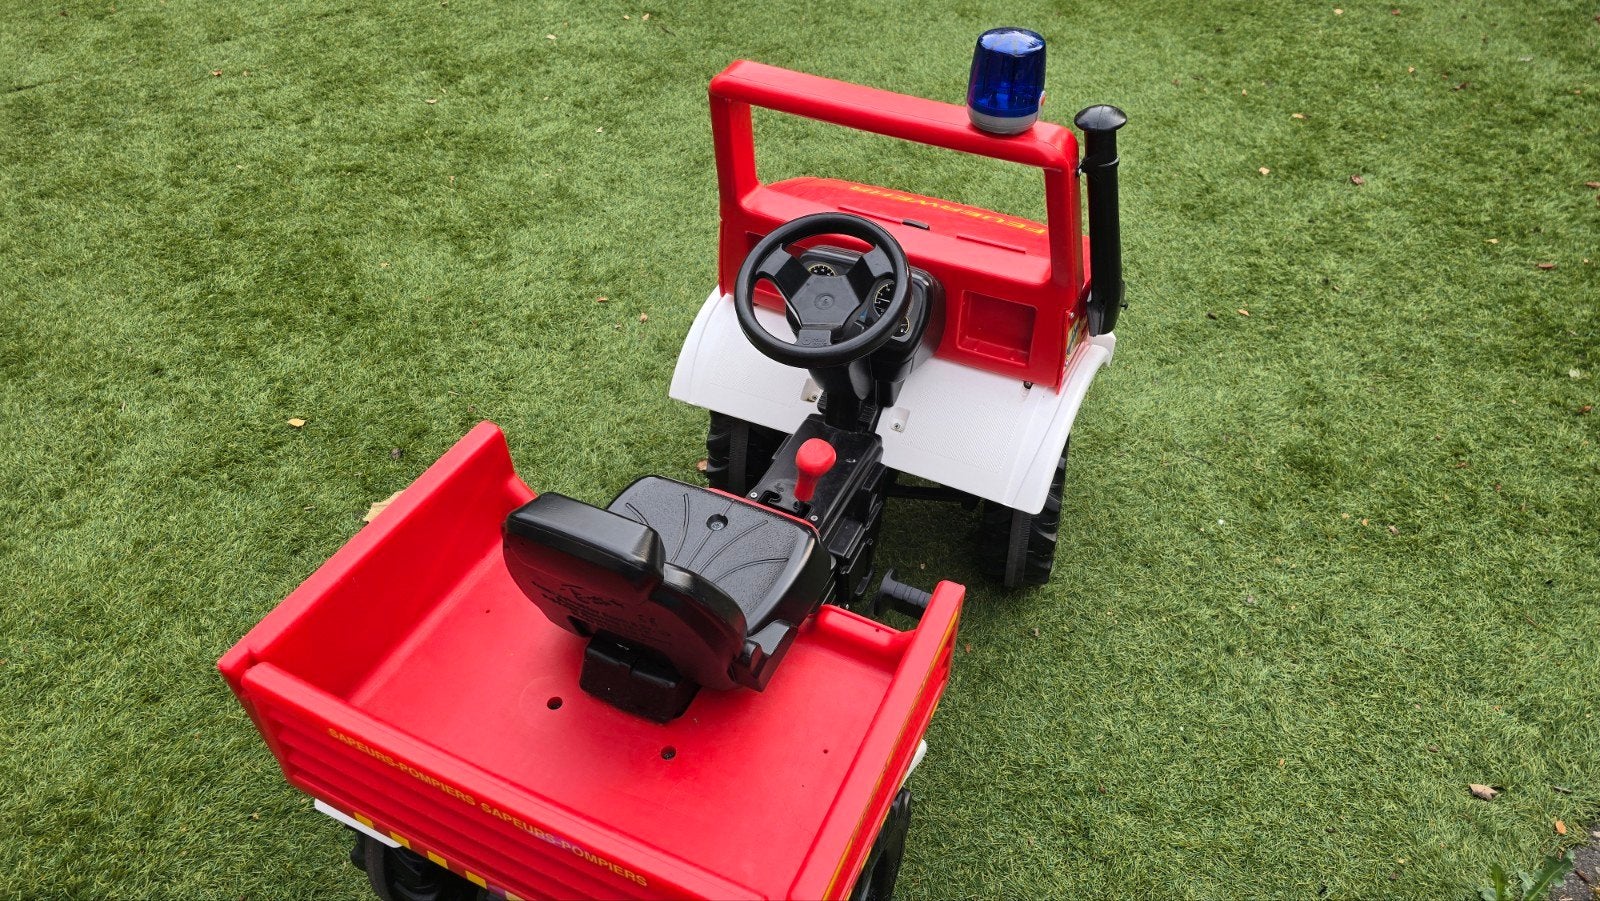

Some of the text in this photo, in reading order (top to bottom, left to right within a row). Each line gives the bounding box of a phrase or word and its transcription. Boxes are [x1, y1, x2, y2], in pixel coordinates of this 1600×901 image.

[850, 185, 1046, 235] FEUERWEHR
[327, 727, 648, 887] SAPEURS-POMPIERS SAPEURS-POMPIERS
